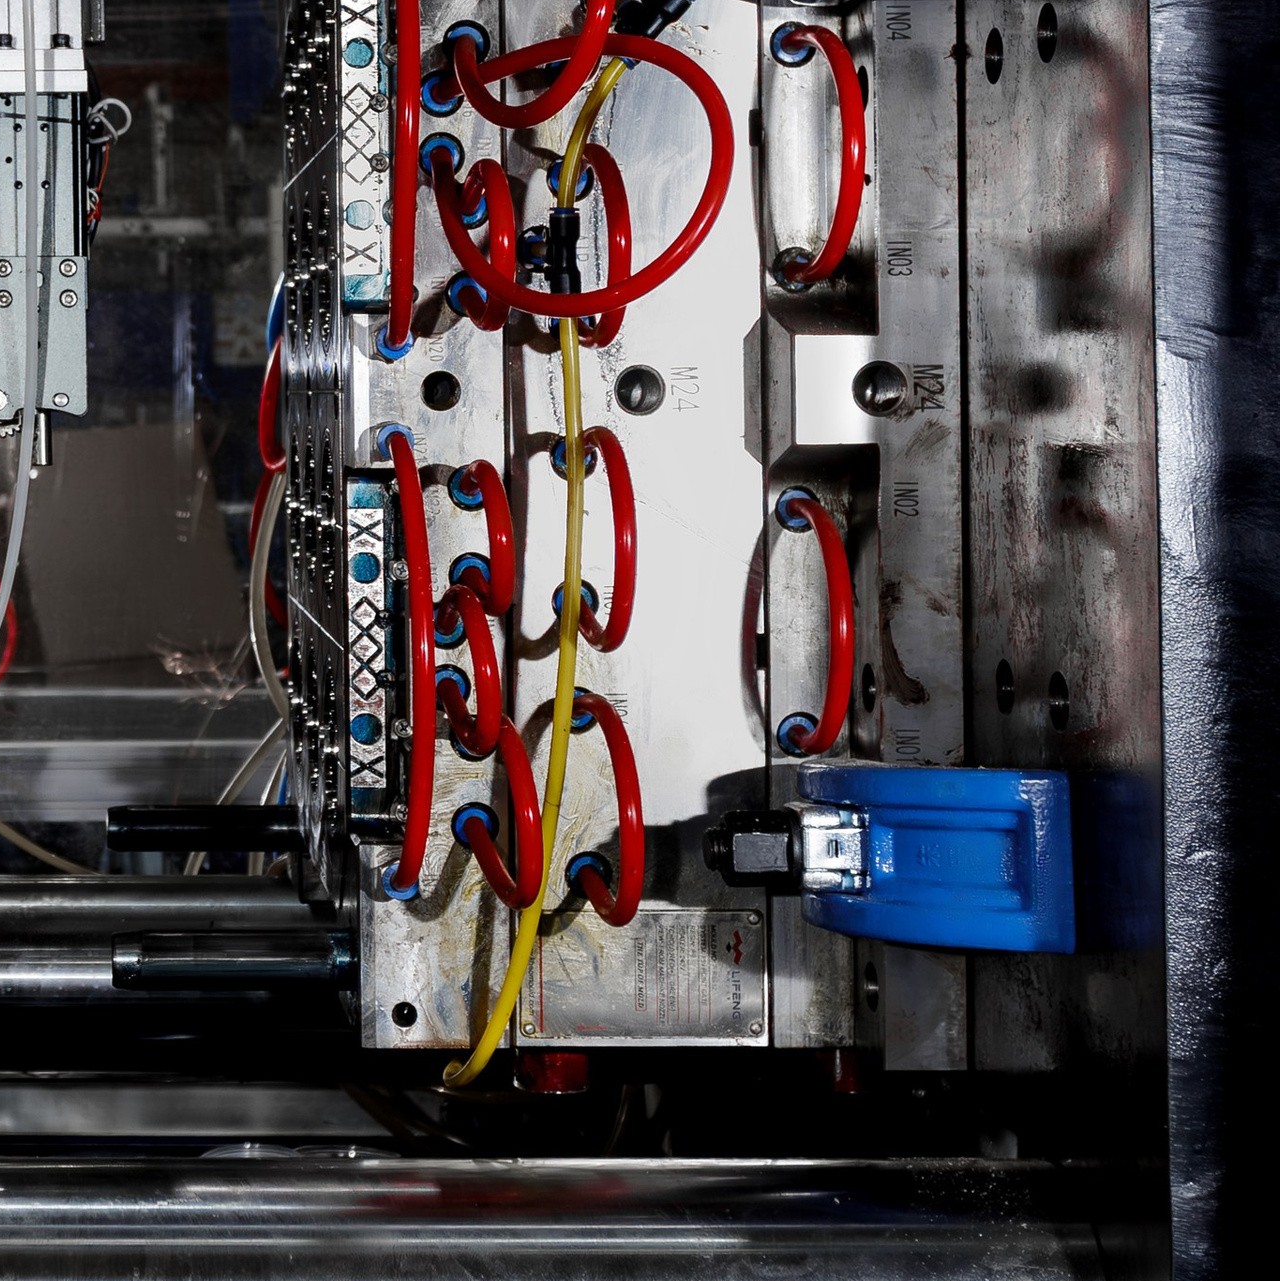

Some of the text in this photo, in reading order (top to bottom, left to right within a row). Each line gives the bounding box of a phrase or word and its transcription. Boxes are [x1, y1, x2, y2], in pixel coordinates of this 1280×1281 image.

[886, 5, 912, 41] IN04
[887, 241, 913, 276] IN03
[671, 367, 700, 412] M24
[914, 364, 946, 413] M24
[894, 481, 920, 517] IN02
[731, 970, 741, 1021] LIFENG
